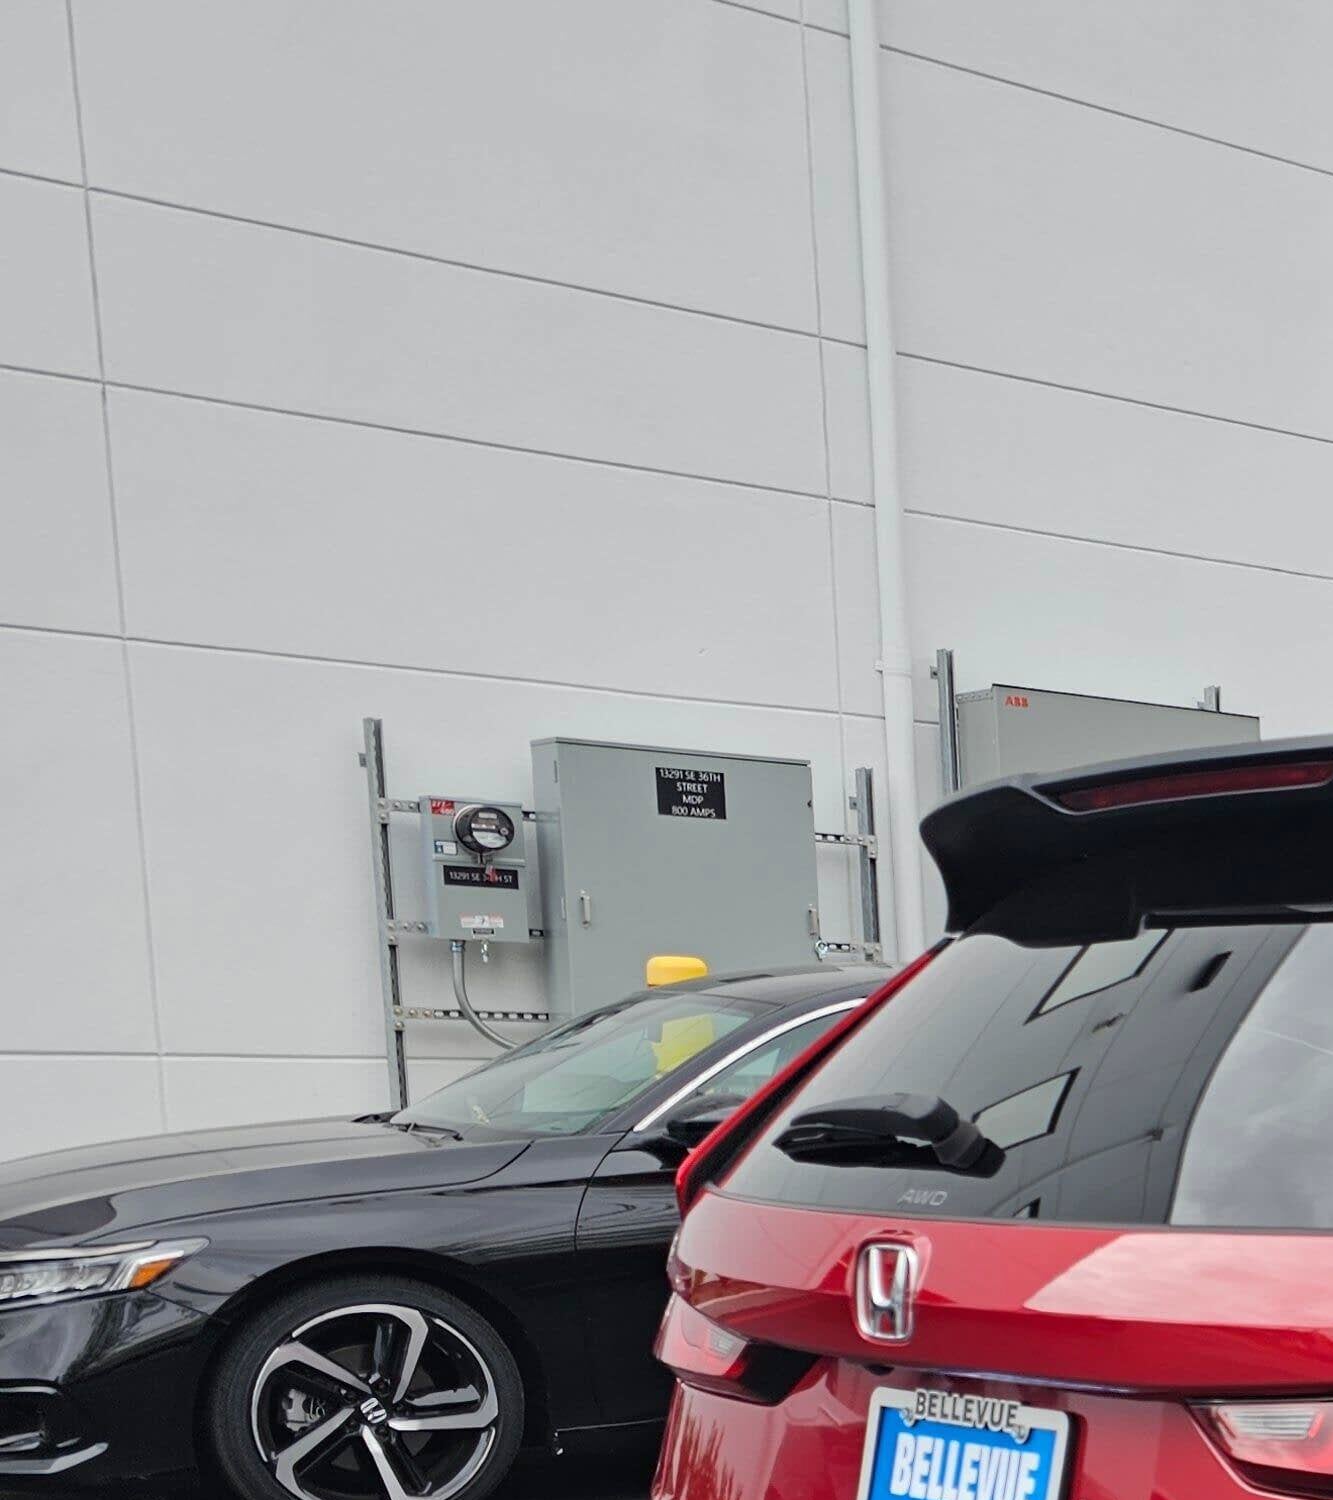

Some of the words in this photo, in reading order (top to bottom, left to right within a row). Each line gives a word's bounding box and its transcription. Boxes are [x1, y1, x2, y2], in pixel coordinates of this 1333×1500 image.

[659, 768, 684, 780] 13291
[685, 770, 695, 781] SE
[698, 771, 721, 783] 36TH
[676, 781, 708, 794] STREET
[682, 794, 704, 805] MDP
[672, 805, 688, 817] 800
[690, 807, 716, 818] AMPS
[897, 1189, 948, 1206] AWD
[915, 1391, 1019, 1428] BELLEVUE
